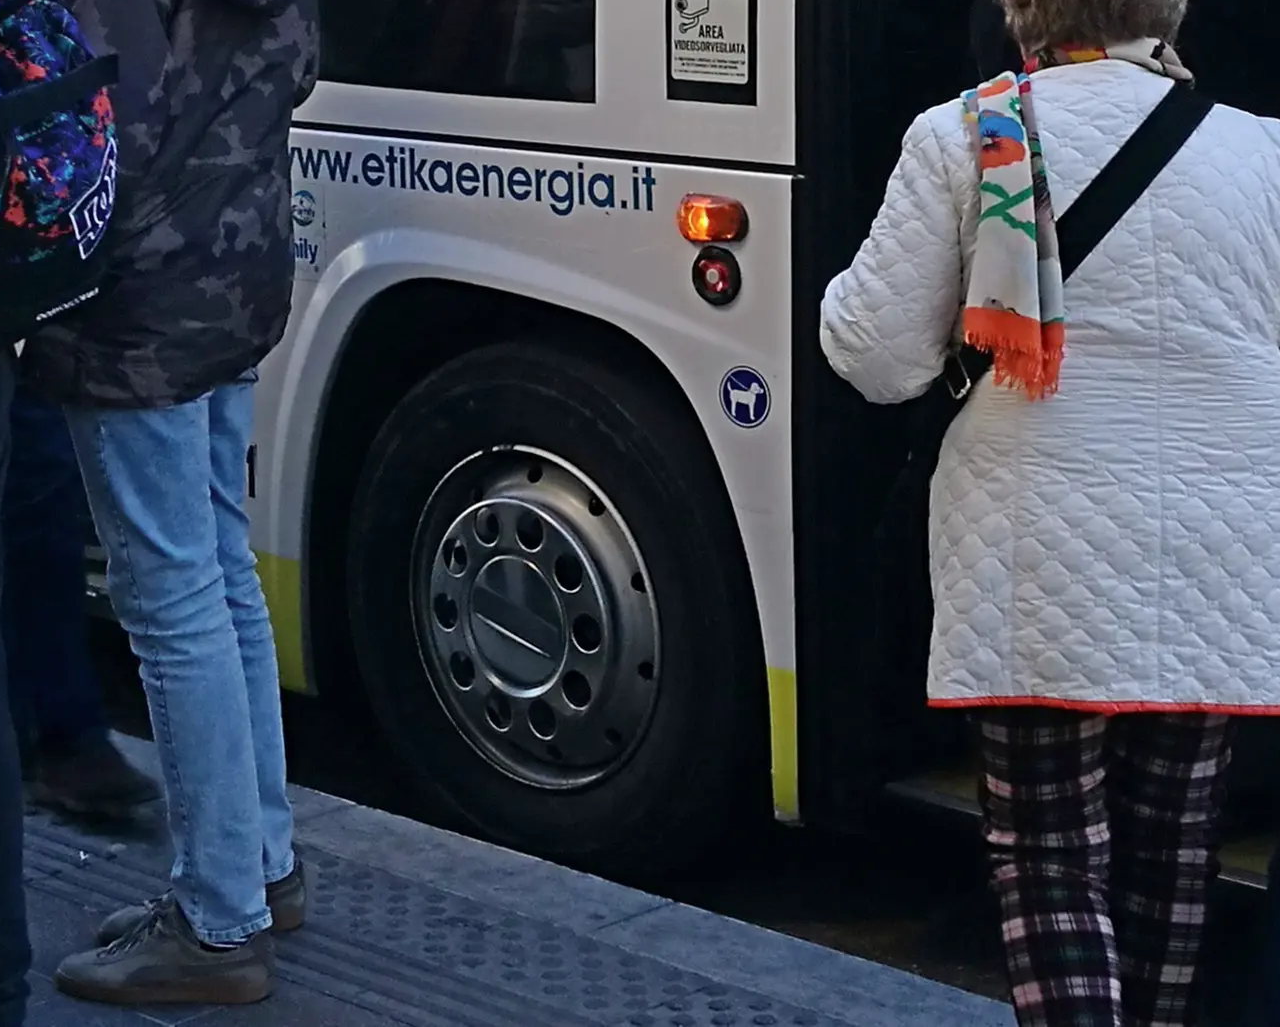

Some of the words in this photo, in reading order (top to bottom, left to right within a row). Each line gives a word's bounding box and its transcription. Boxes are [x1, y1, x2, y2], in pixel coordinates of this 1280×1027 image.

[698, 24, 725, 40] AREA
[673, 39, 746, 55] VIDEOSORVEGLIATA
[289, 144, 657, 216] ww.etikaenergia.it
